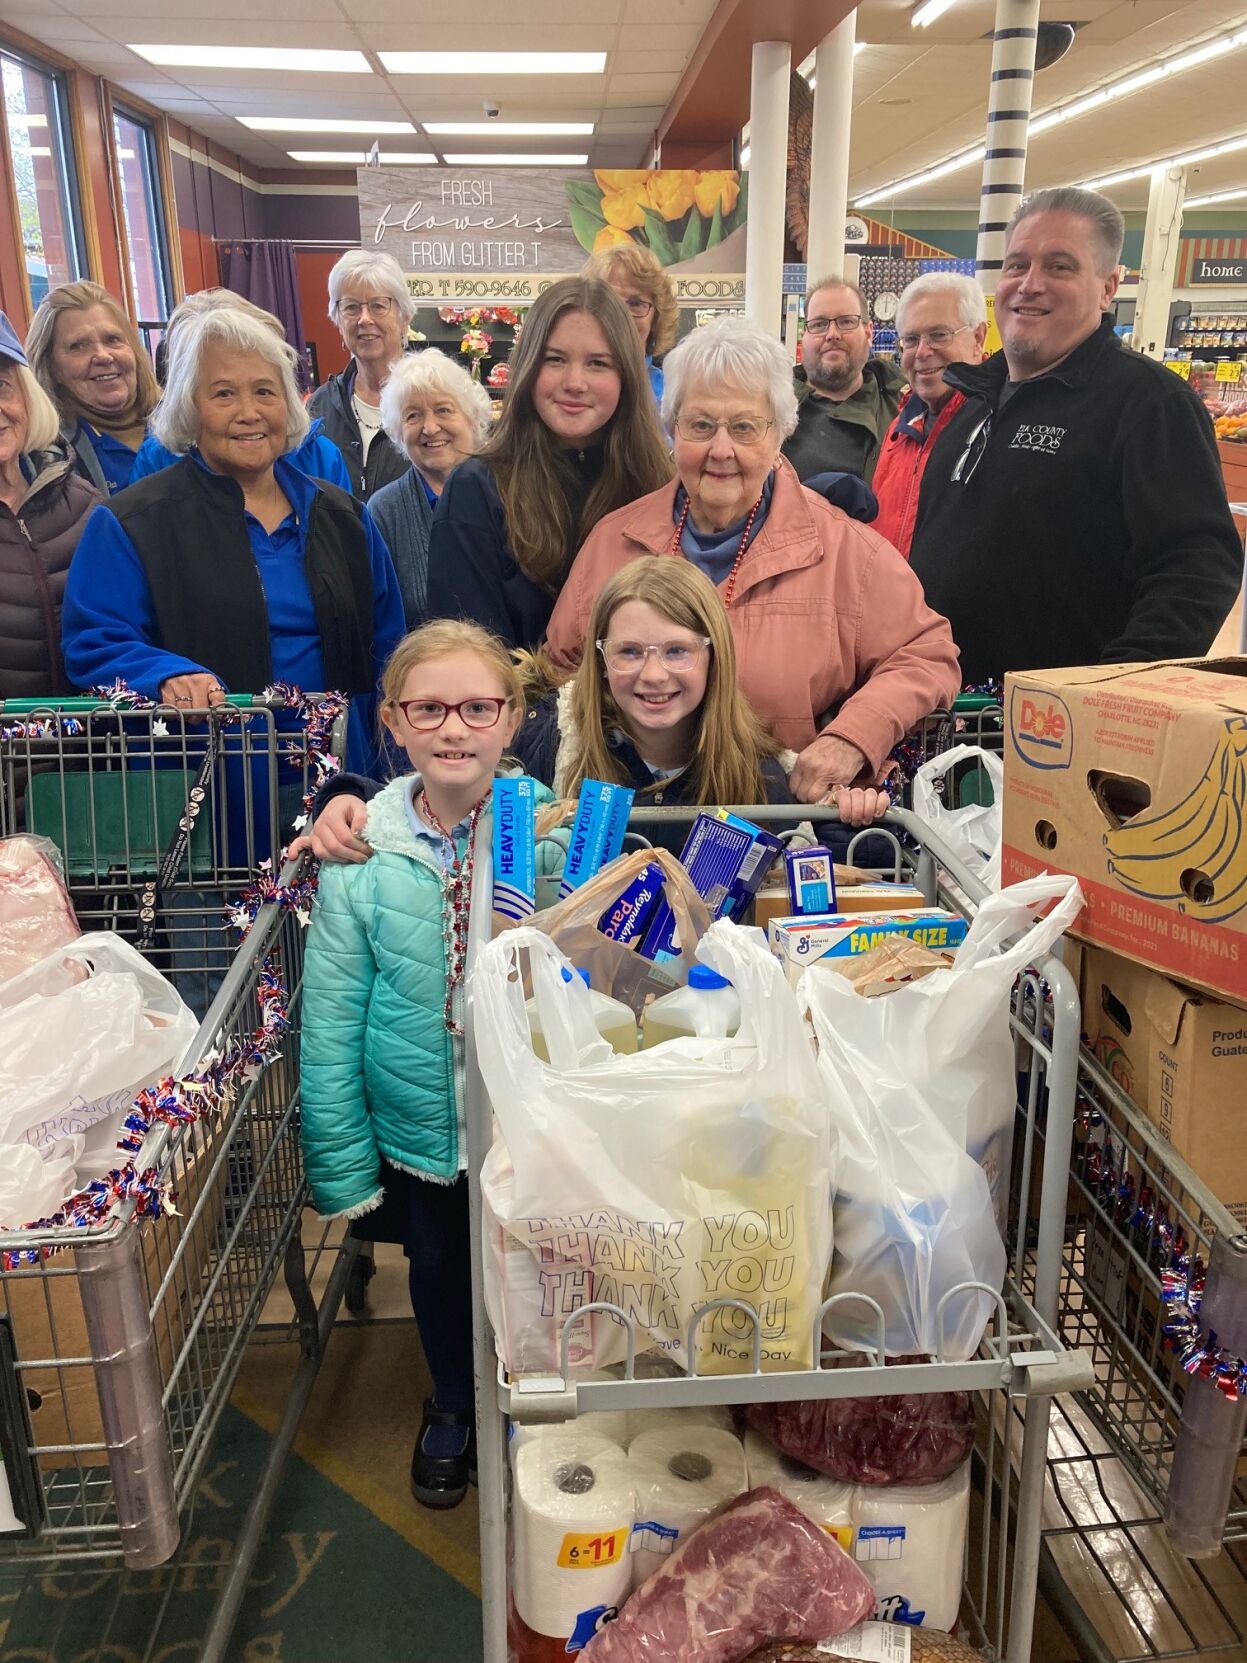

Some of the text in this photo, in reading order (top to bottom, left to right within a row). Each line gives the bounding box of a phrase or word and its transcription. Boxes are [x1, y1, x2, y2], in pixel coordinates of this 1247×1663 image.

[441, 180, 493, 206] FRESH
[374, 200, 562, 244] flowers
[411, 242, 542, 266] FROM GLITTER T
[1200, 261, 1243, 277] home
[439, 280, 450, 297] T
[455, 280, 532, 297] 590-9646
[1011, 432, 1061, 449] FOODS
[1032, 425, 1067, 437] COUNTY
[1020, 699, 1066, 738] Dole
[1143, 706, 1181, 722] COMPANY
[500, 788, 513, 875] HEAVYDUTY
[568, 790, 596, 875] HEAVYDUTY
[620, 888, 652, 936] Reynolds
[912, 927, 948, 946] SIZE
[1110, 900, 1240, 961] PREMIUM BANANAS
[1159, 1051, 1179, 1073] COUNT
[702, 1204, 795, 1253] YOU
[696, 1256, 795, 1293] YOU
[711, 1342, 749, 1360] Nice
[759, 1350, 792, 1362] Day
[569, 1546, 580, 1558] 6
[588, 1535, 616, 1560] 11
